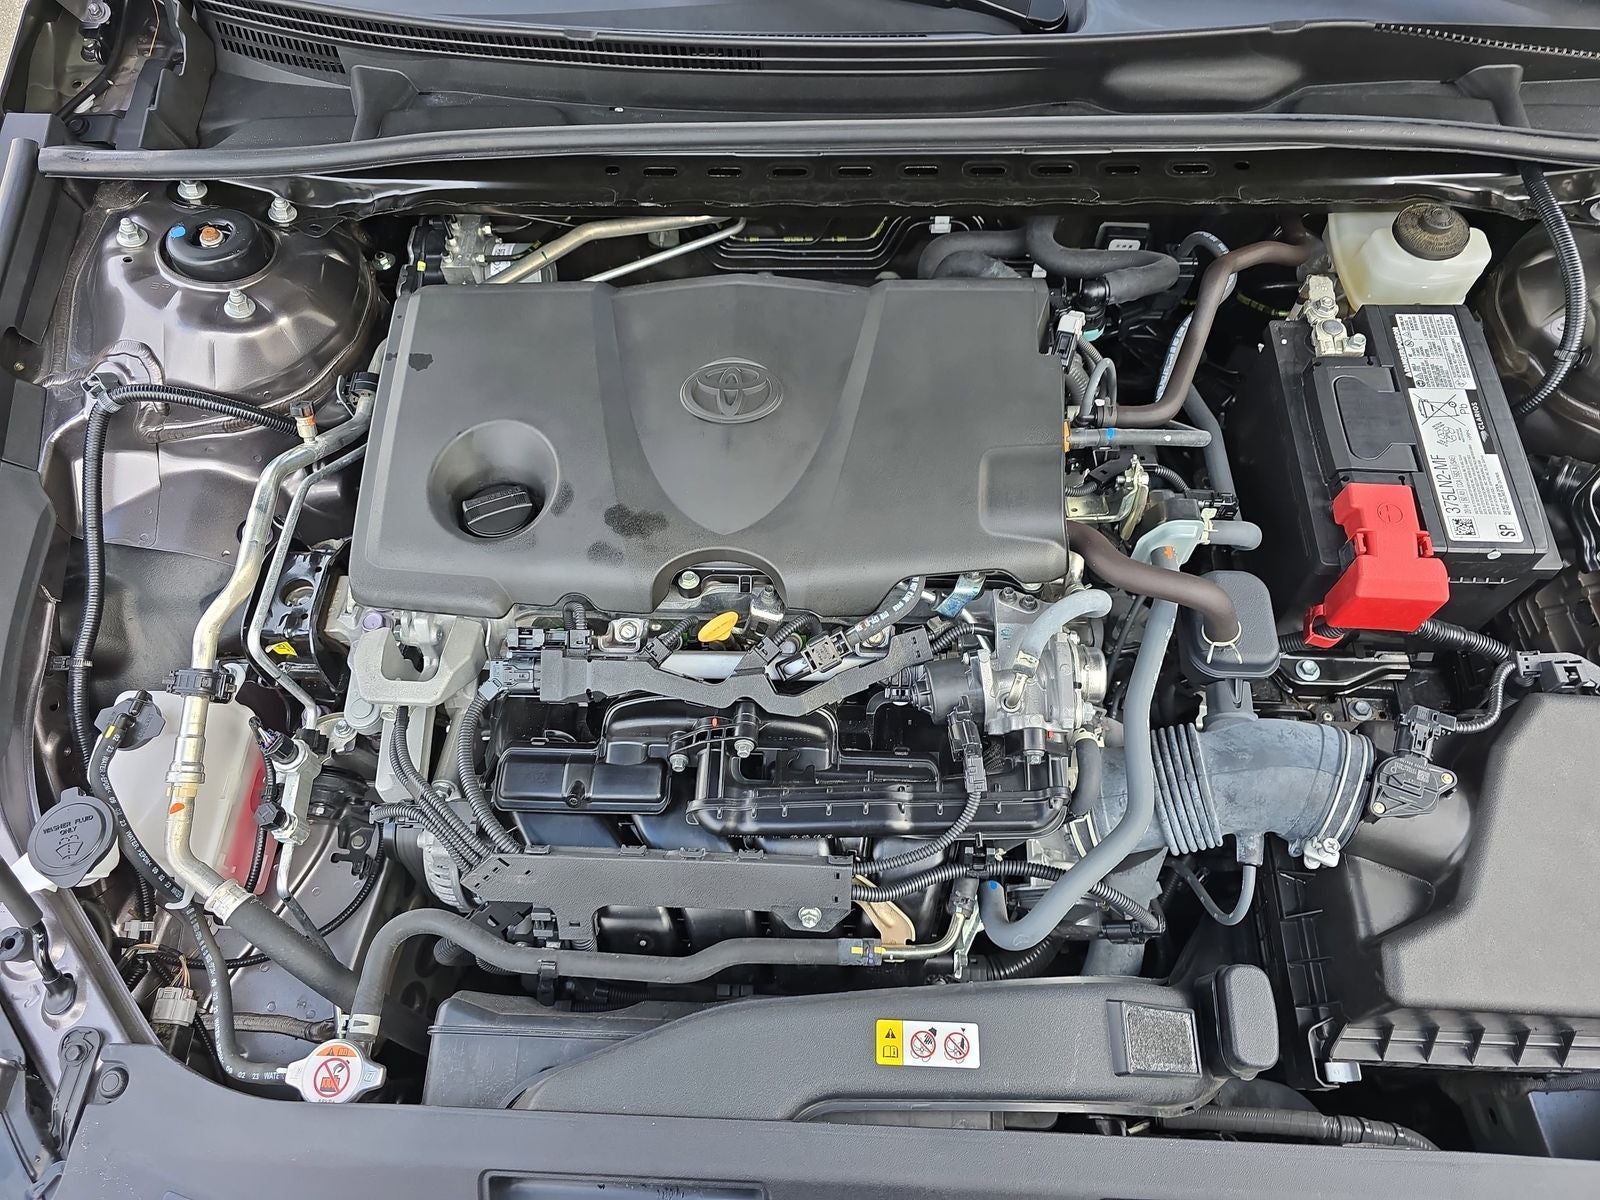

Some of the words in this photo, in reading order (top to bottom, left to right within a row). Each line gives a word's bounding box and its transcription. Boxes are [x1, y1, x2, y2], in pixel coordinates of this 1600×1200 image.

[1458, 403, 1469, 414] Pb
[1471, 402, 1484, 429] CLARIOS
[1430, 453, 1460, 513] 375LN2-MF
[1499, 525, 1516, 538] SP
[43, 822, 72, 834] WASHER
[75, 815, 94, 825] FLUID
[59, 826, 77, 835] ONLY
[125, 830, 138, 848] WATER
